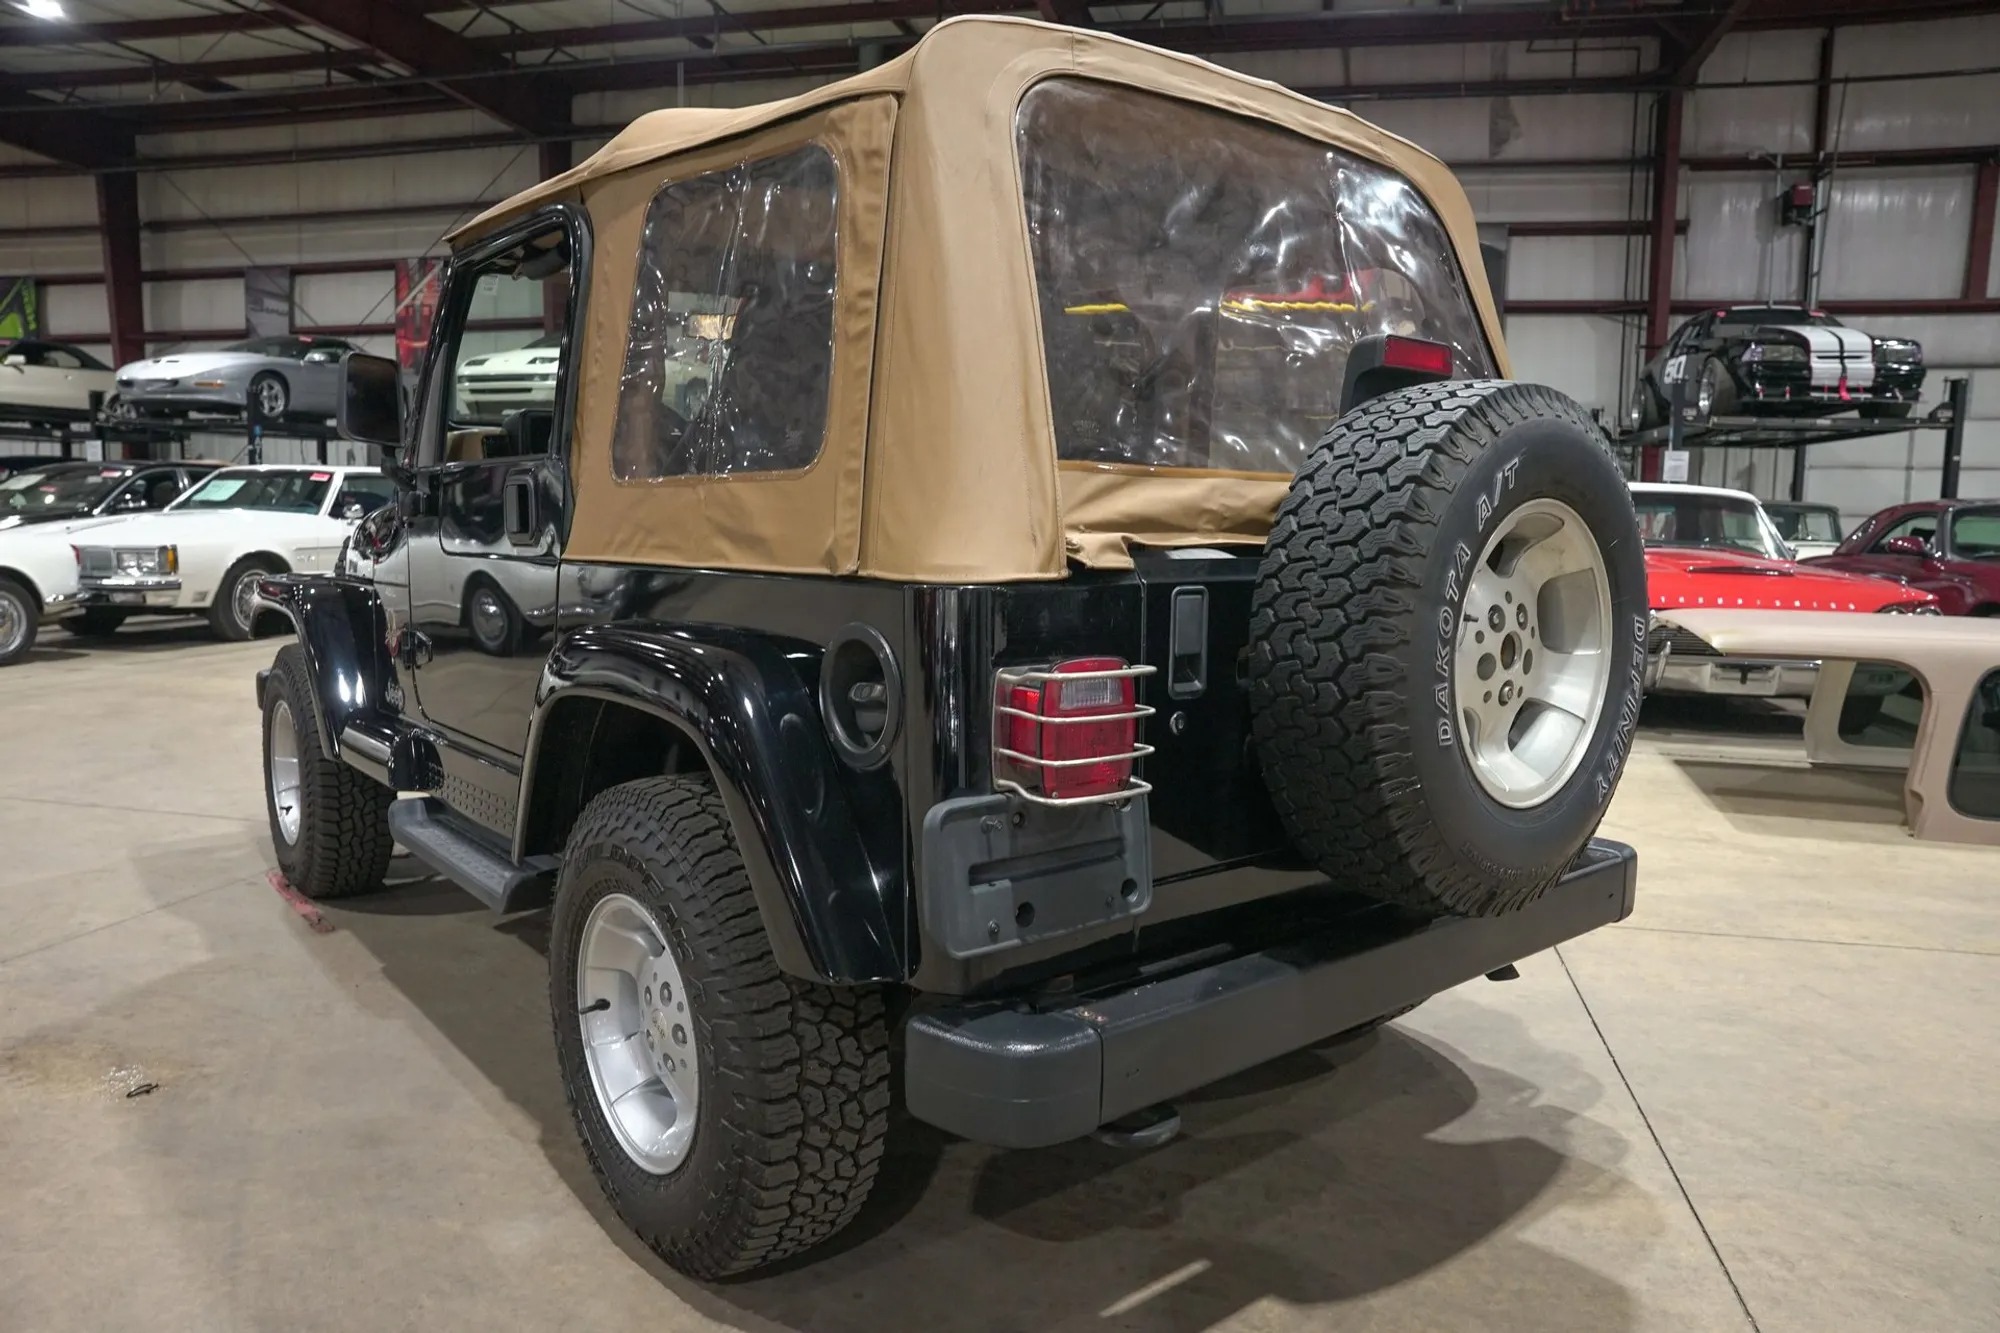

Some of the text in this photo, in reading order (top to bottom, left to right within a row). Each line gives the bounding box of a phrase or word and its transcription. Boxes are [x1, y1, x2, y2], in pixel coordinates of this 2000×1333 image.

[1434, 457, 1519, 746] DAKOTA A/T
[1597, 615, 1645, 804] DEFINITY
